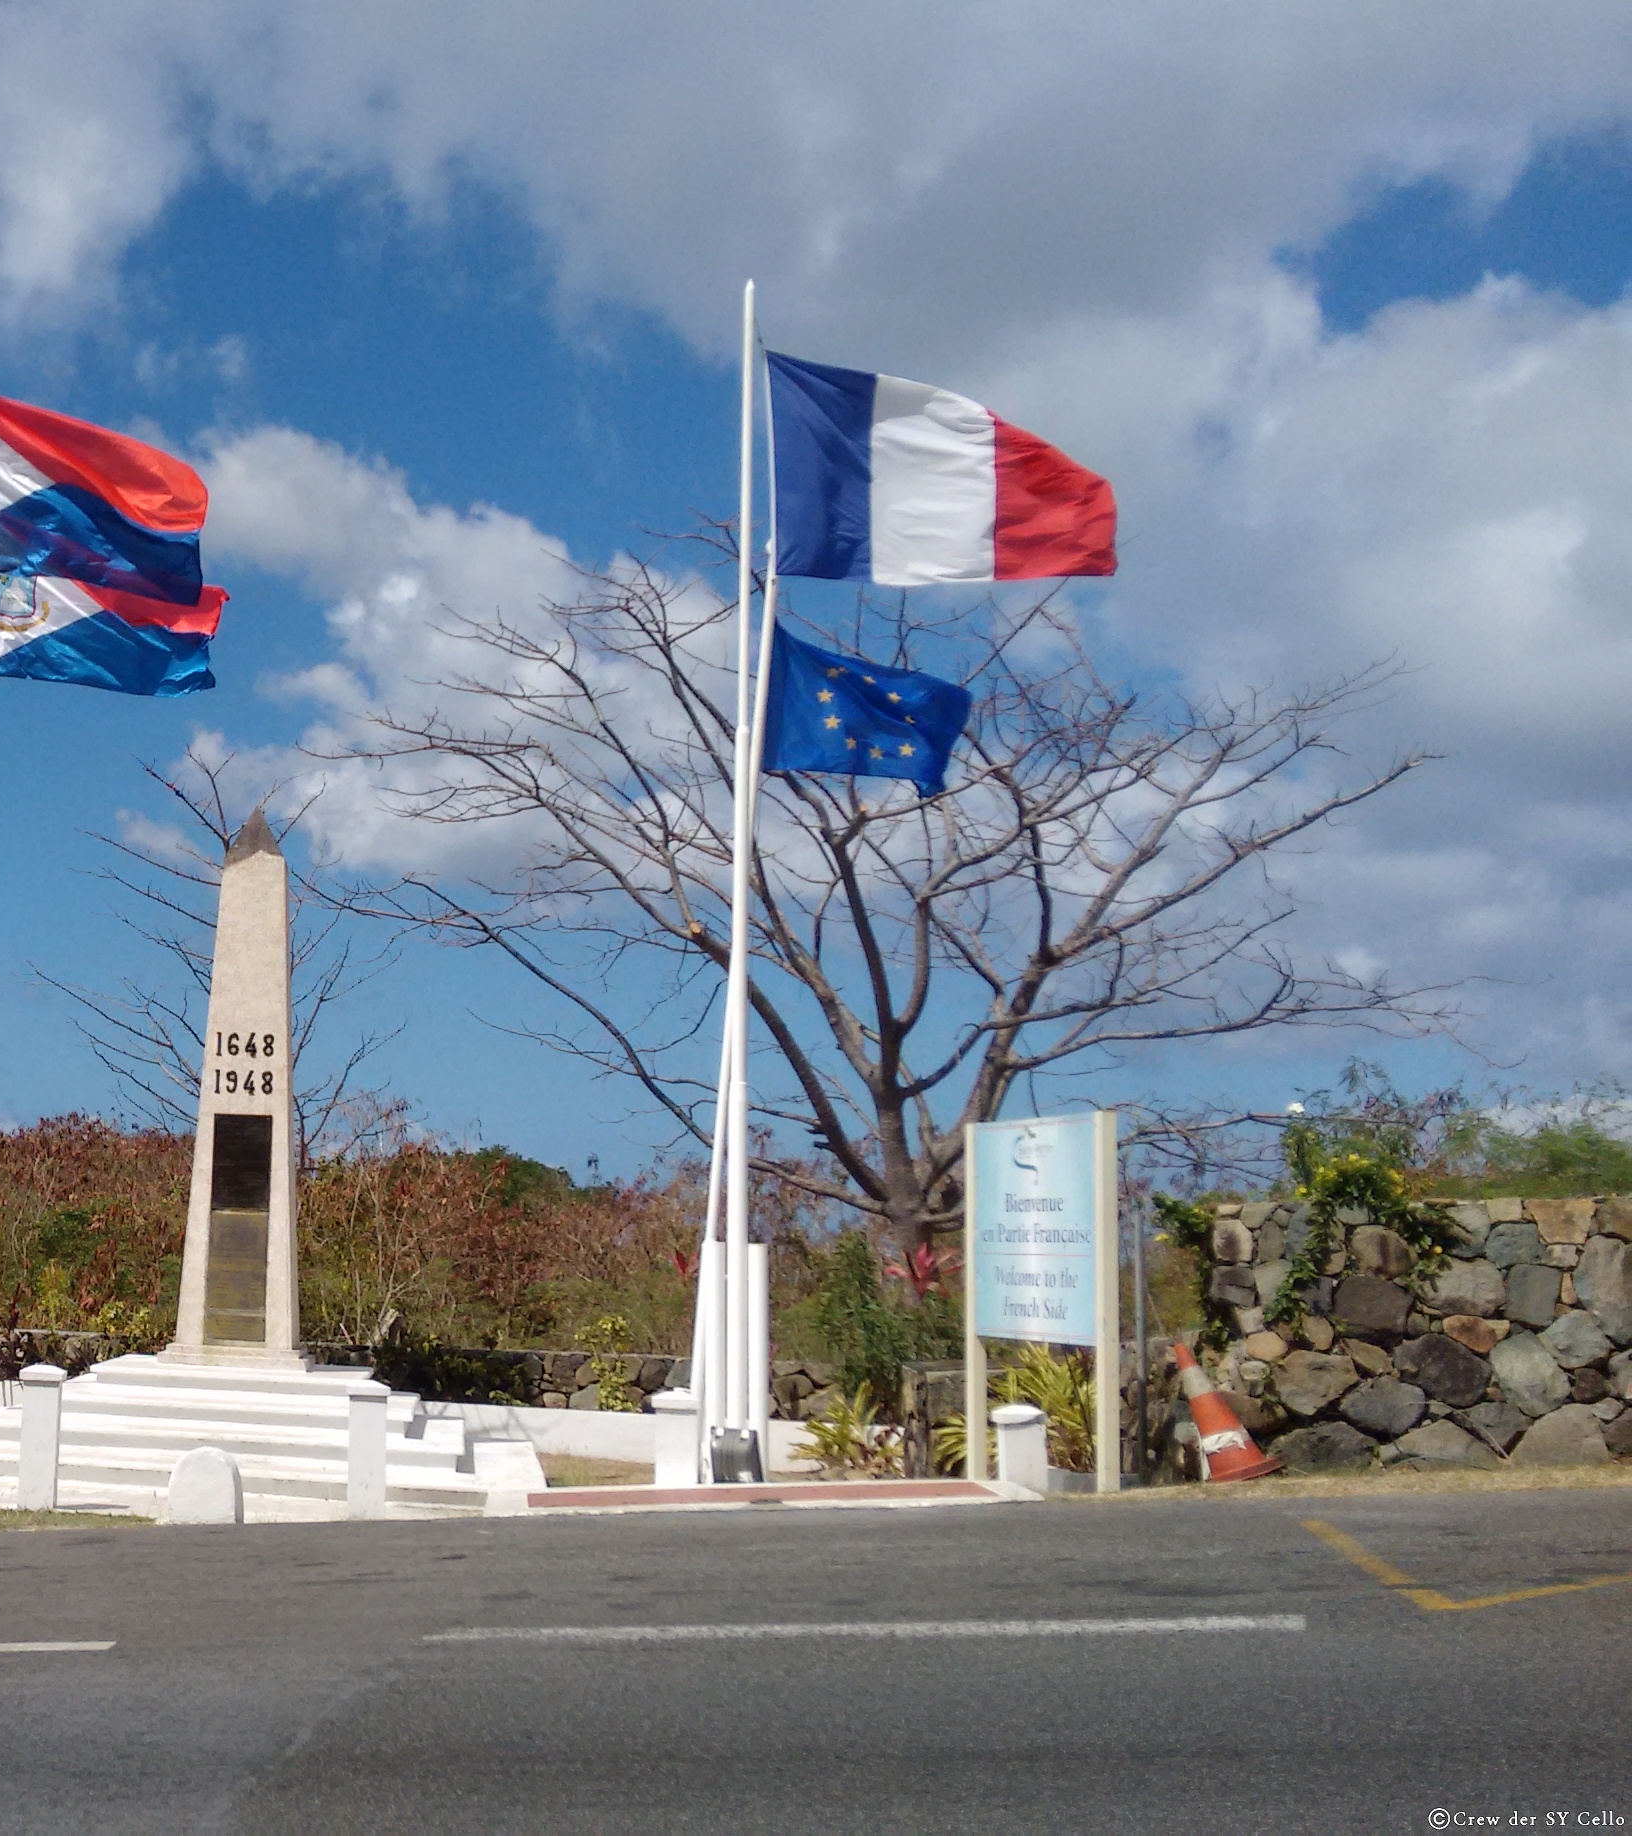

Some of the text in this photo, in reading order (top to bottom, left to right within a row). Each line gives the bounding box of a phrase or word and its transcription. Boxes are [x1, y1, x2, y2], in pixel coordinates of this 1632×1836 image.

[216, 1031, 275, 1058] 1648
[214, 1069, 273, 1096] 1948
[1005, 1193, 1064, 1213] Bienvenue
[983, 1223, 1090, 1249] en Partie Française
[995, 1266, 1078, 1289] Welcome to the
[1003, 1296, 1068, 1320] French Side
